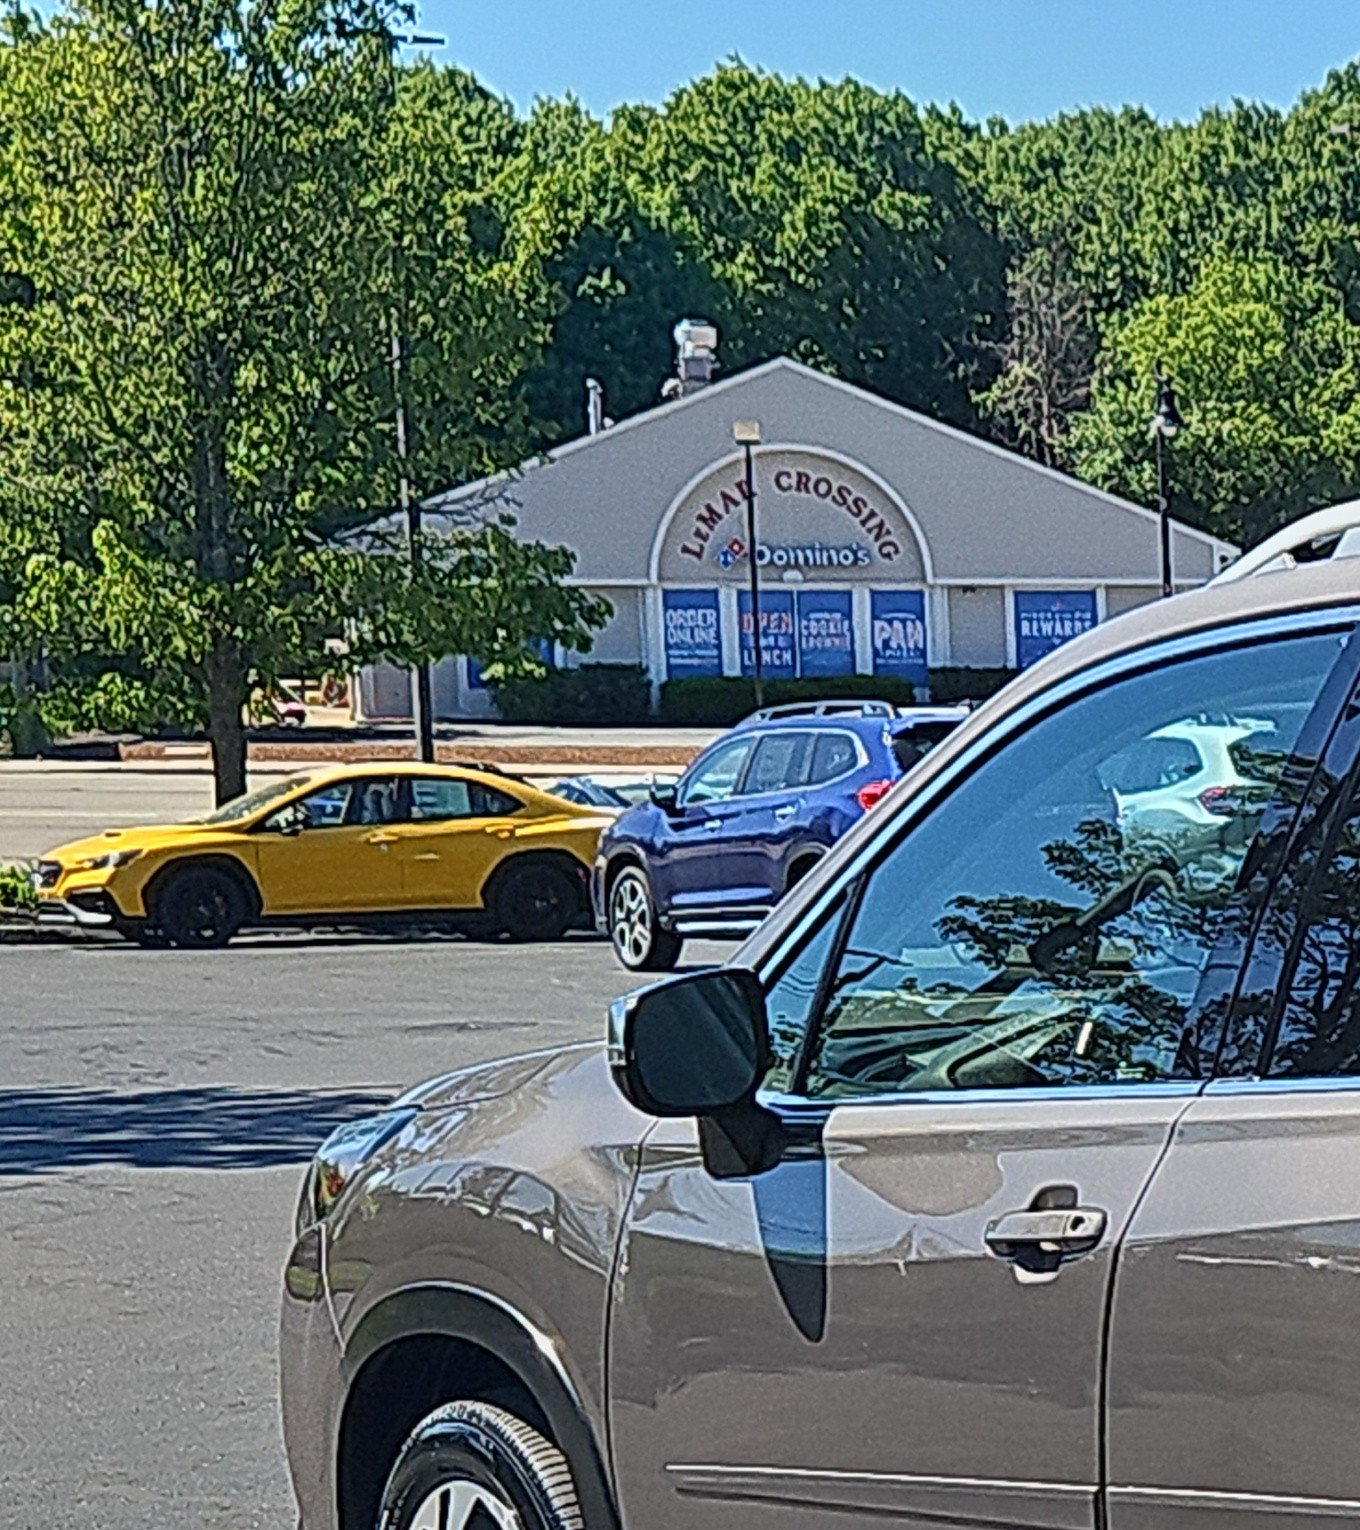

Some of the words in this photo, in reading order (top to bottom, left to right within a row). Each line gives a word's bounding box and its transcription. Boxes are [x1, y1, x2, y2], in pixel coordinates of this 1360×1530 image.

[773, 470, 901, 562] CROSSING
[755, 543, 870, 567] Domino's
[666, 608, 718, 627] ORDER
[667, 626, 719, 645] ONLINE
[873, 619, 924, 656] PAN
[1020, 619, 1092, 638] REWARDS
